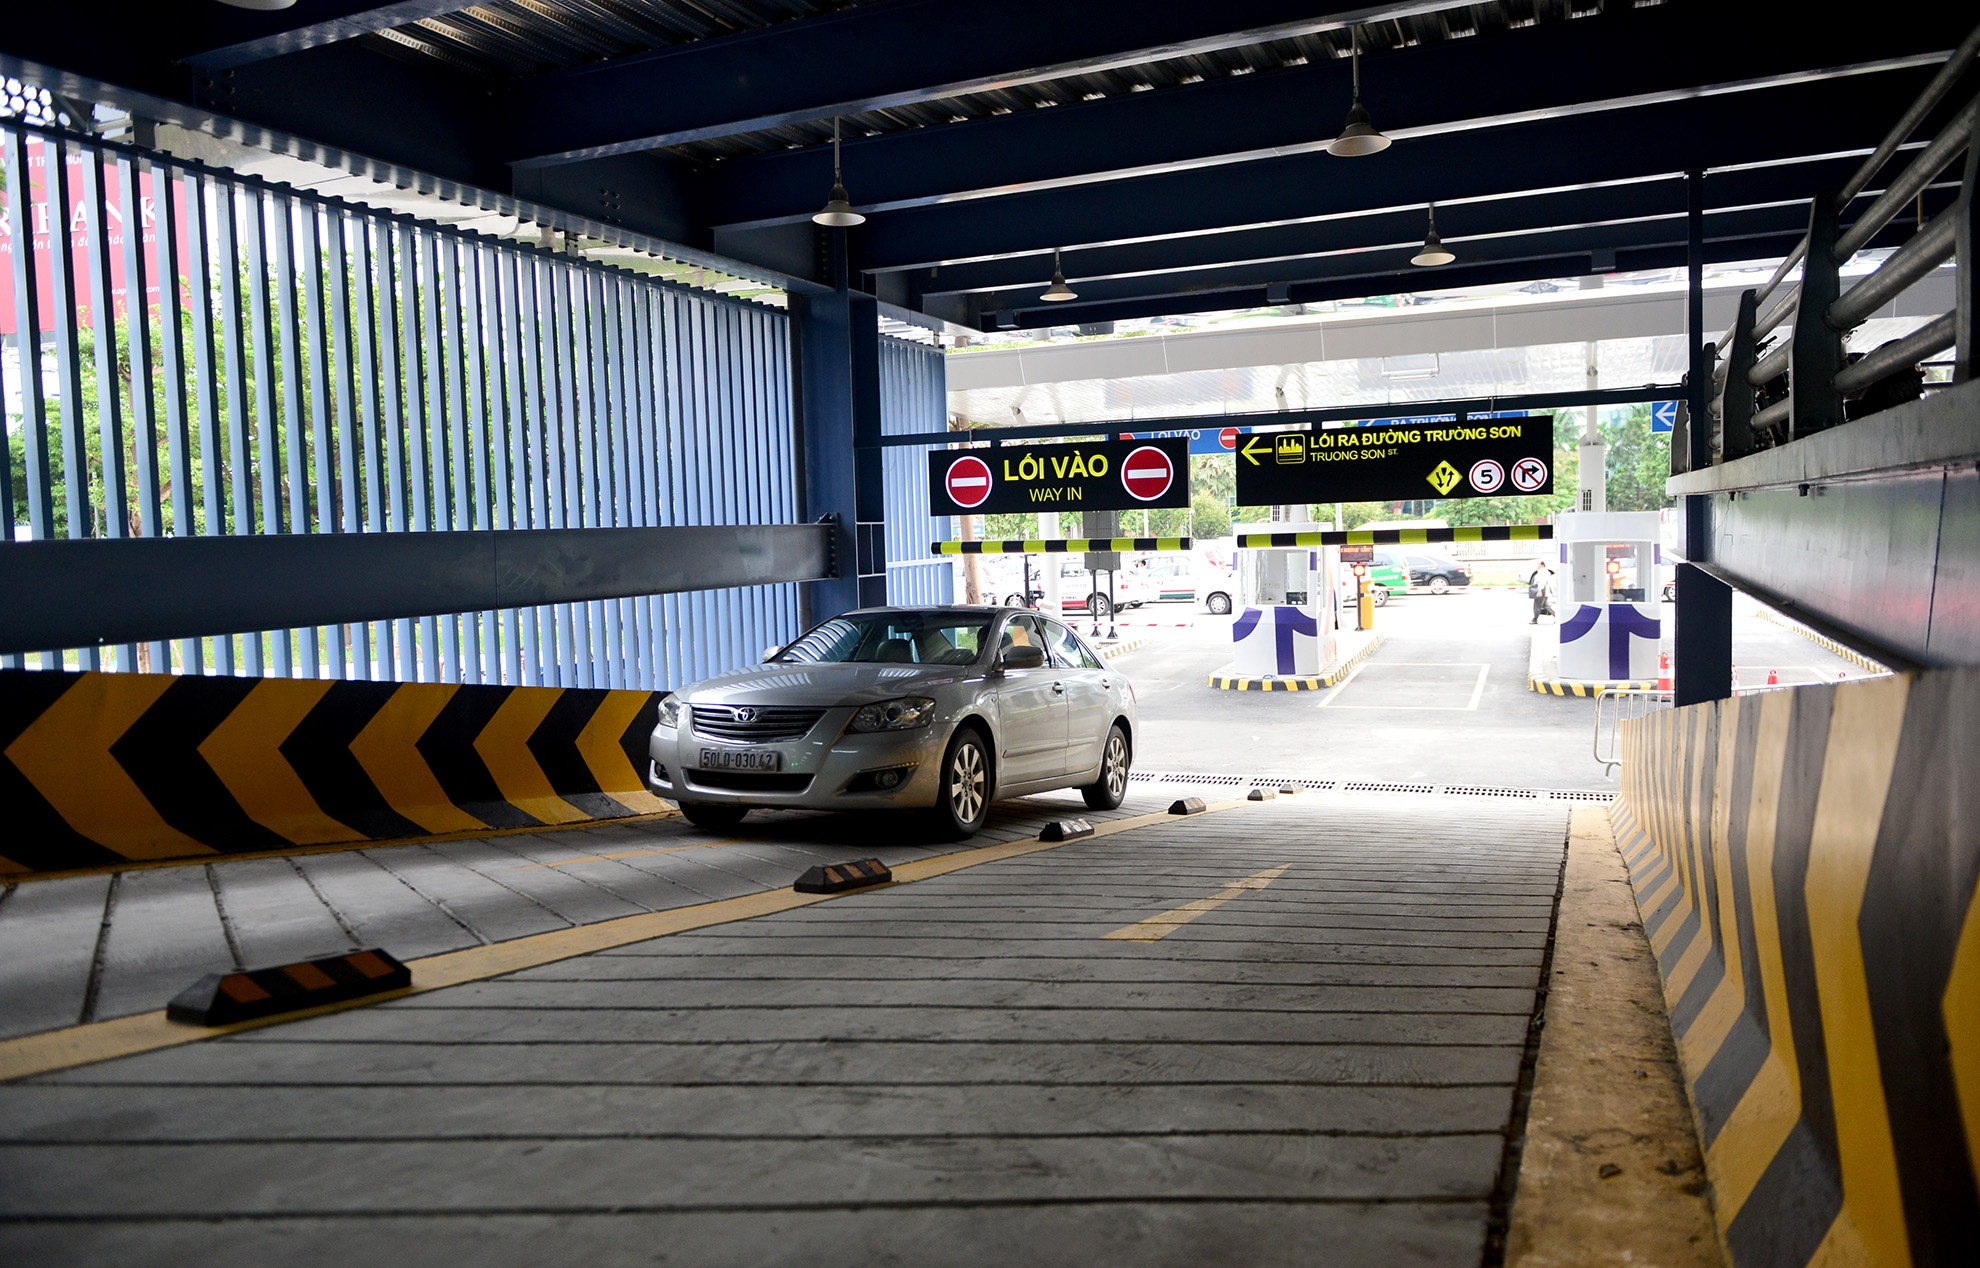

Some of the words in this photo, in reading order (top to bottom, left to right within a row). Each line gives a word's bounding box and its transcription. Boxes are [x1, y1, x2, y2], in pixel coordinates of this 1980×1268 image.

[1338, 433, 1360, 447] RA
[1361, 428, 1421, 446] ĐƯỜNG
[1424, 426, 1487, 442] TRƯỜNG
[1489, 425, 1522, 439] SƠN
[1310, 450, 1358, 462] TRUONG
[1360, 448, 1386, 460] SON
[1387, 448, 1399, 456] ST.
[1004, 452, 1045, 481] LỐI
[1051, 450, 1109, 479] VÀO
[1480, 469, 1493, 485] 5
[1029, 486, 1064, 502] WAY
[1067, 486, 1082, 501] IN
